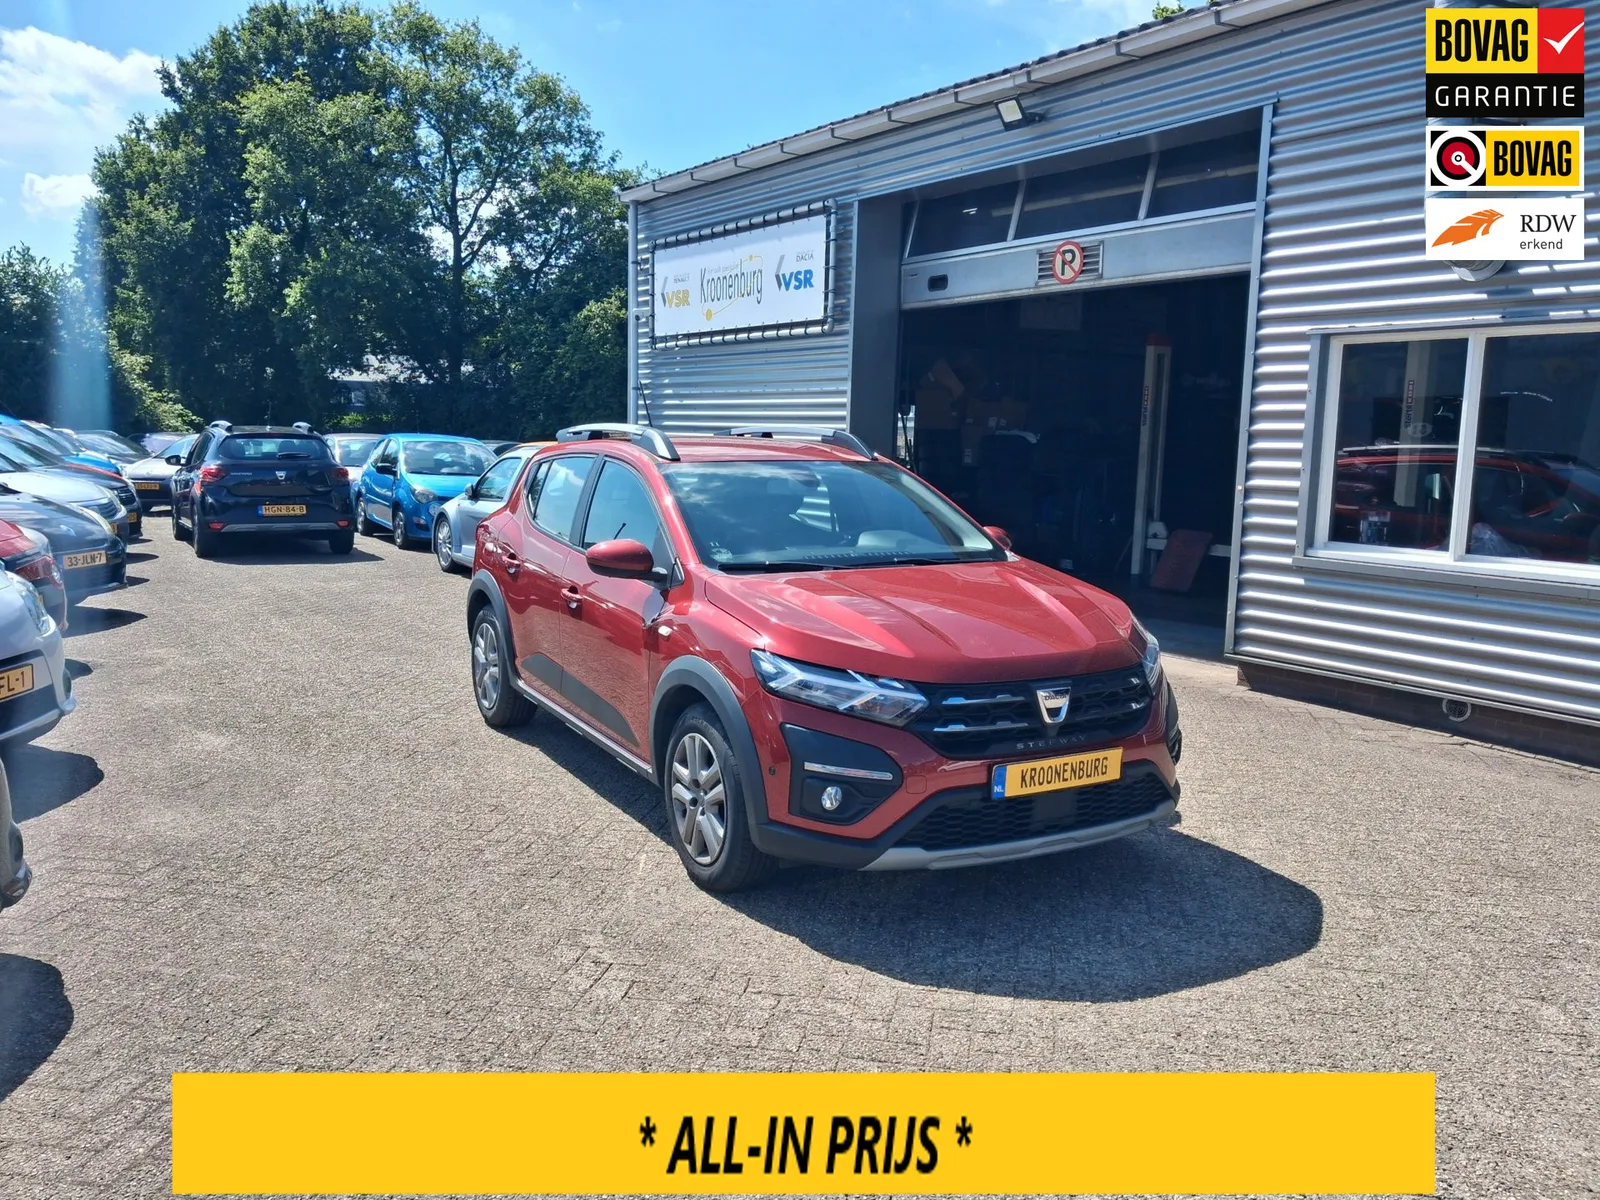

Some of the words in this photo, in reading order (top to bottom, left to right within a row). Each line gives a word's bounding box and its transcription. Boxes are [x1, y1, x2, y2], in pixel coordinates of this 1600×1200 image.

[796, 252, 814, 263] DACIA
[700, 258, 763, 305] Kroonenburg
[781, 269, 814, 291] VSR
[665, 289, 691, 308] VSR
[67, 552, 103, 567] 33-JLN-7
[1020, 756, 1109, 789] KROONENBURG
